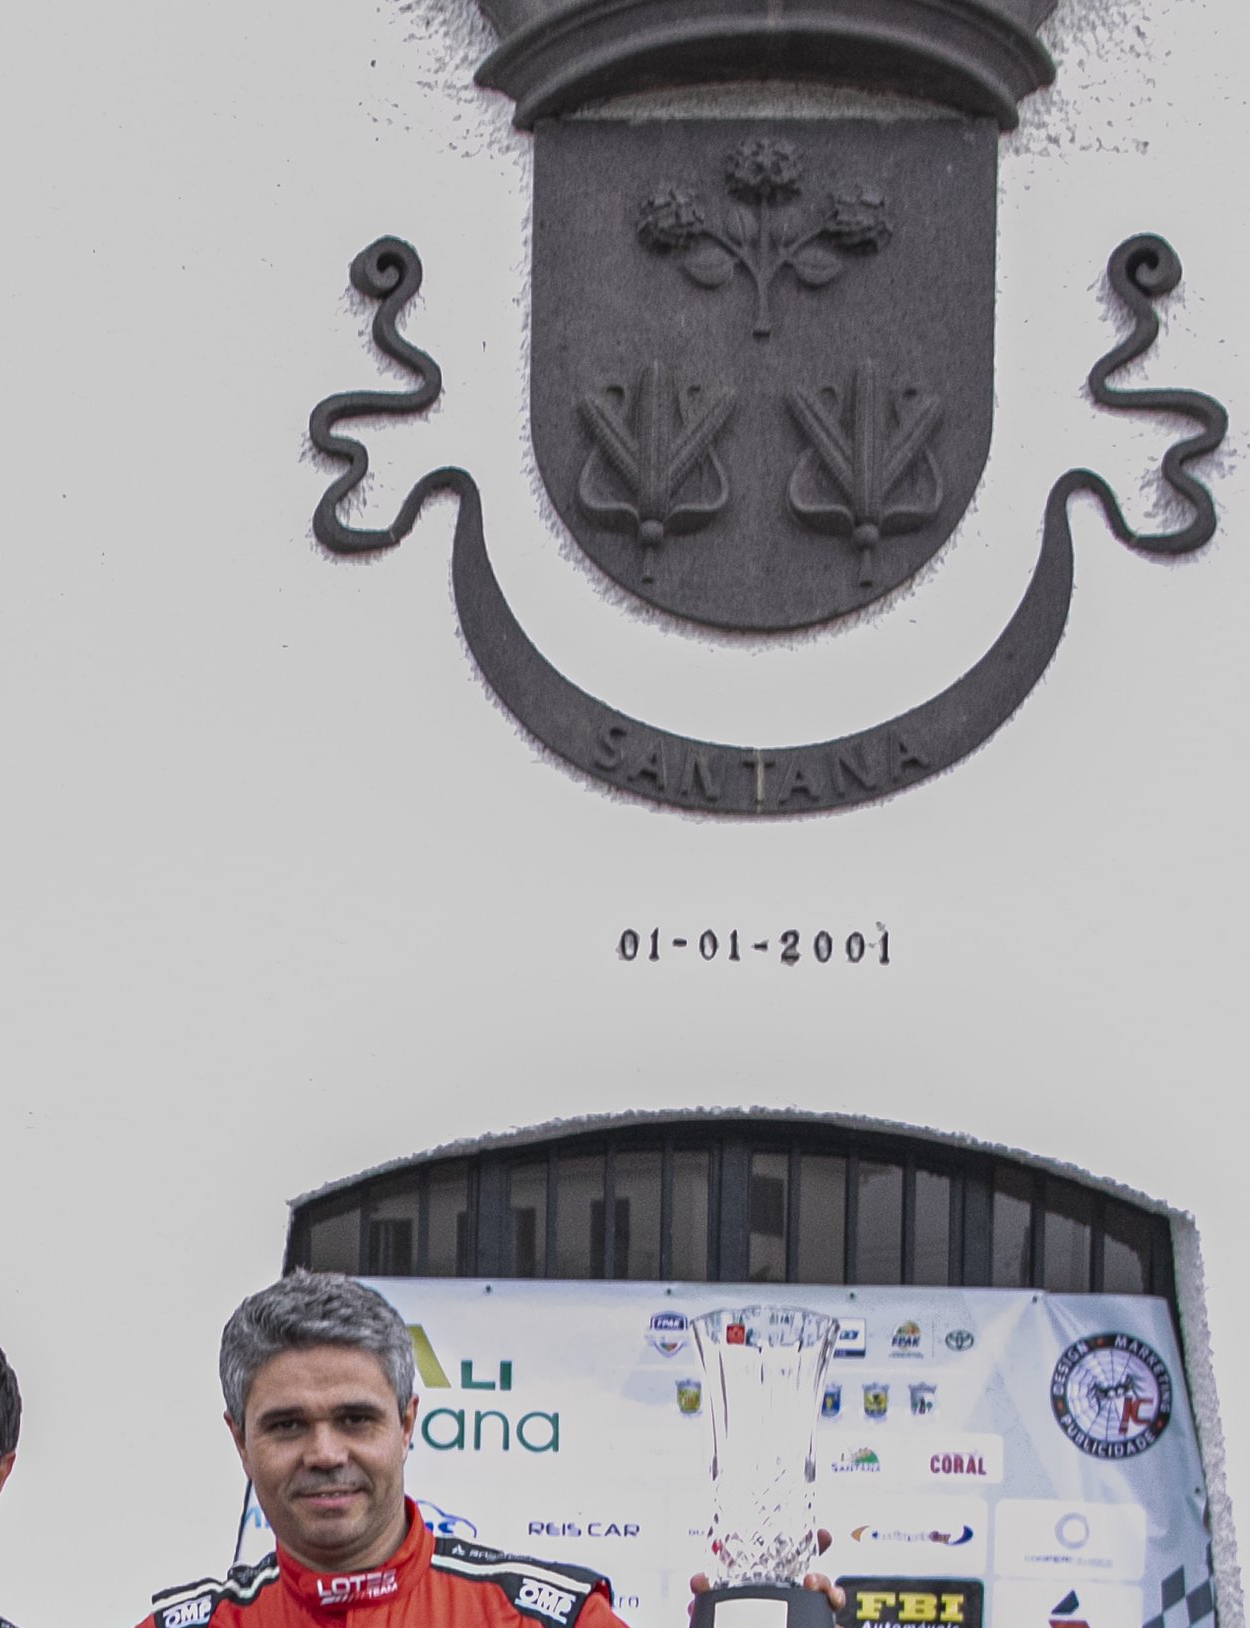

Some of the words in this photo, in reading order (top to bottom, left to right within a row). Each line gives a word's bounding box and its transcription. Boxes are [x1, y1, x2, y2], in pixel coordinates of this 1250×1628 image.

[593, 726, 931, 805] SANTANA
[618, 927, 891, 965] 01-01-2001
[1053, 1341, 1089, 1396] DESIGN
[1061, 1413, 1156, 1457] PUBLICIDADE
[930, 1453, 987, 1476] CORAL
[587, 1522, 640, 1538] CAR
[517, 1579, 576, 1623] OMP
[856, 1591, 964, 1622] FBI
